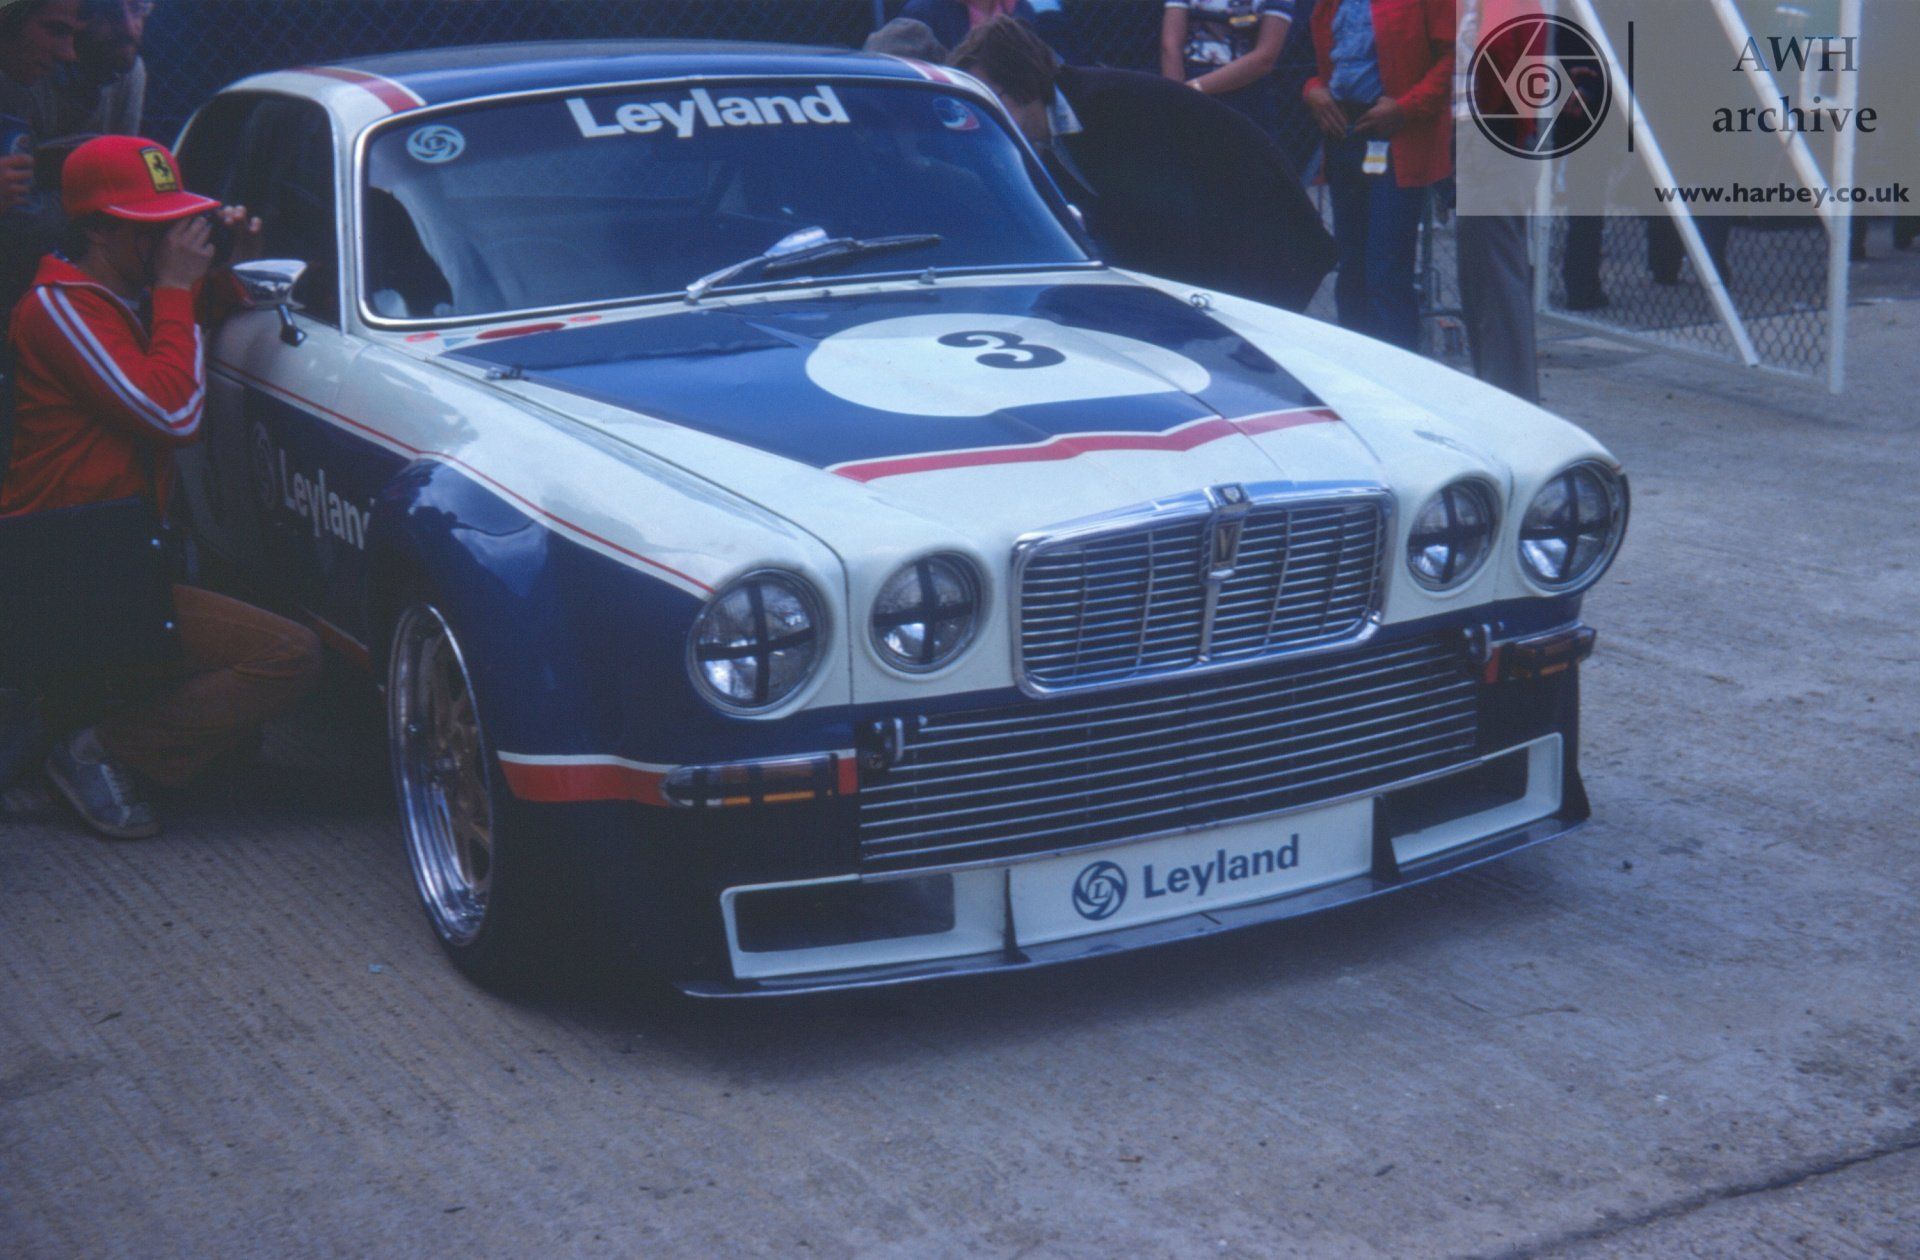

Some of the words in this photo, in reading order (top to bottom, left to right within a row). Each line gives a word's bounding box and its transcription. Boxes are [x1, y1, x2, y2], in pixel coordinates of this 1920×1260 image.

[565, 84, 851, 138] Leyland
[936, 329, 1067, 370] 3
[1142, 833, 1299, 899] Leyland
